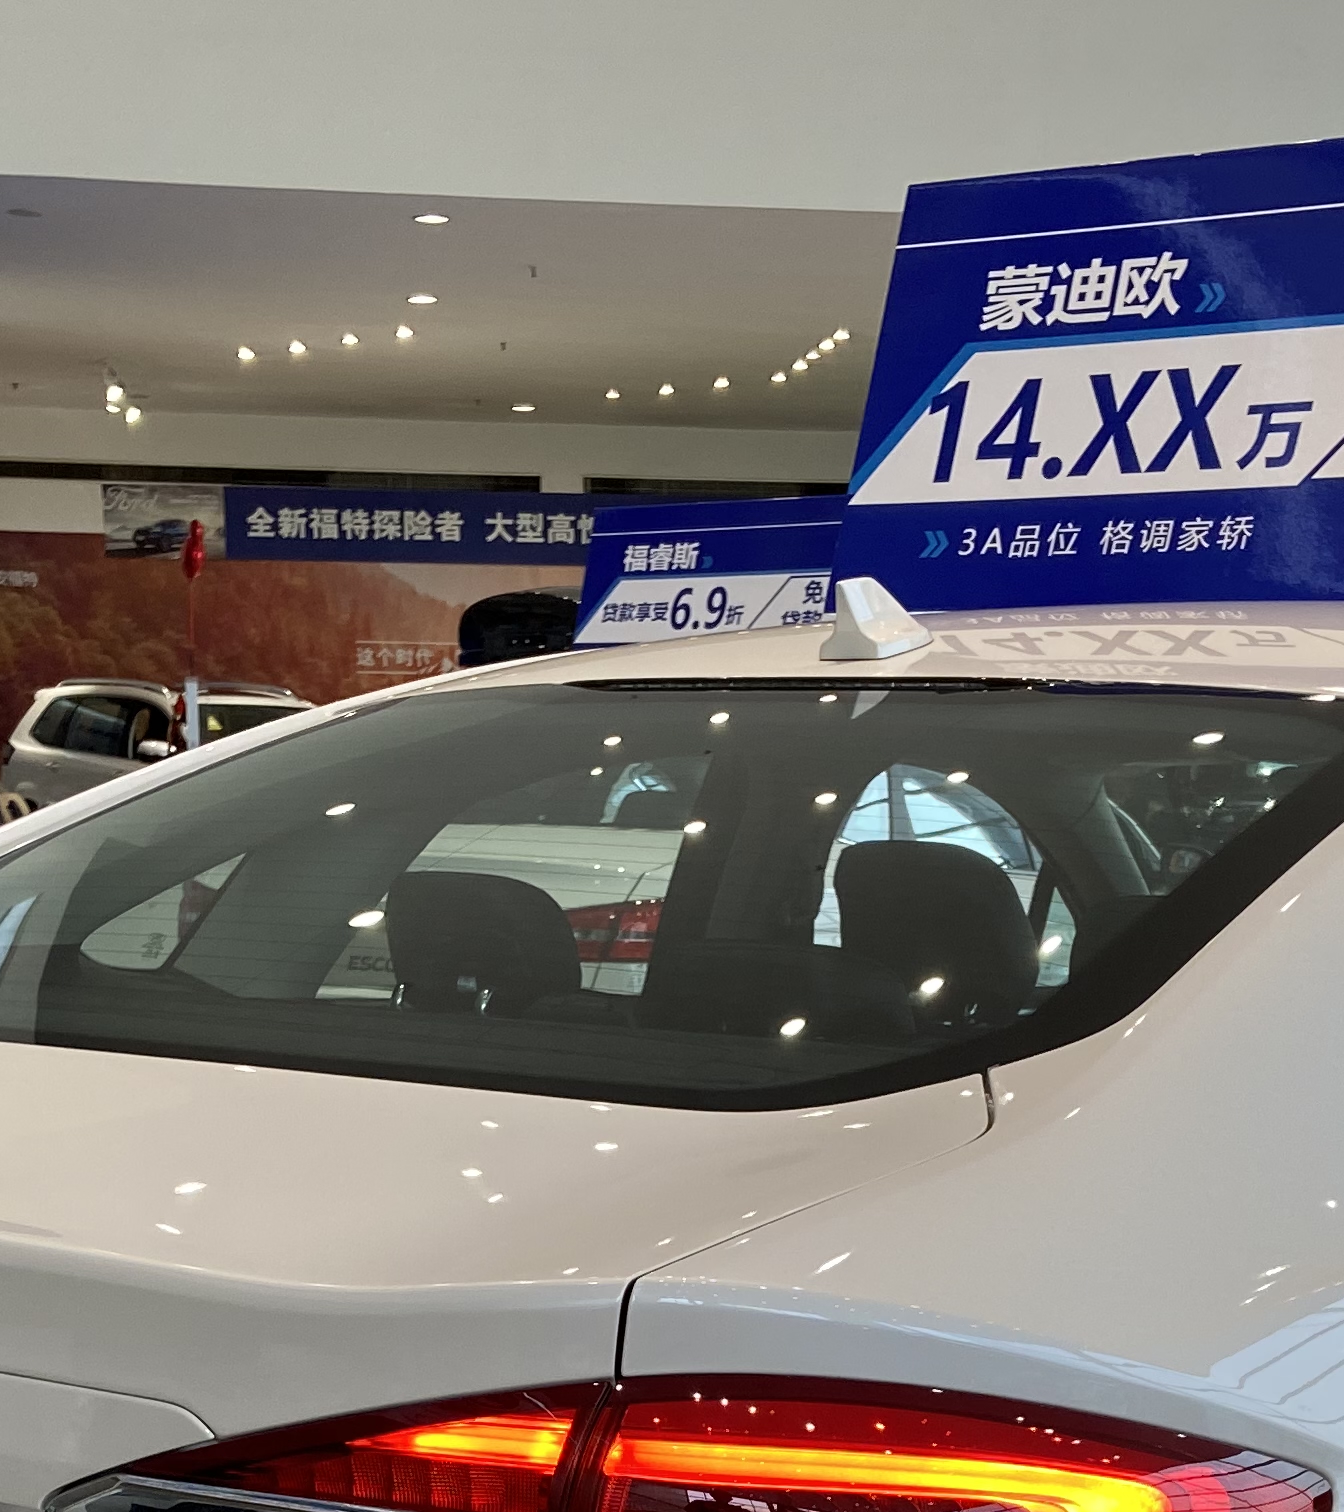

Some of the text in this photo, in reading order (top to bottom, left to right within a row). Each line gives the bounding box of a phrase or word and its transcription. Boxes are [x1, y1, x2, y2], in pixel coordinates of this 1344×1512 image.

[979, 252, 1189, 331] 蒙迪欧
[246, 507, 464, 543] 全新福特探险者
[958, 515, 1256, 558] 3A品位 格调家轿
[623, 542, 700, 573] 福睿斯
[802, 580, 826, 605] 免
[356, 647, 434, 668] 这个时代
